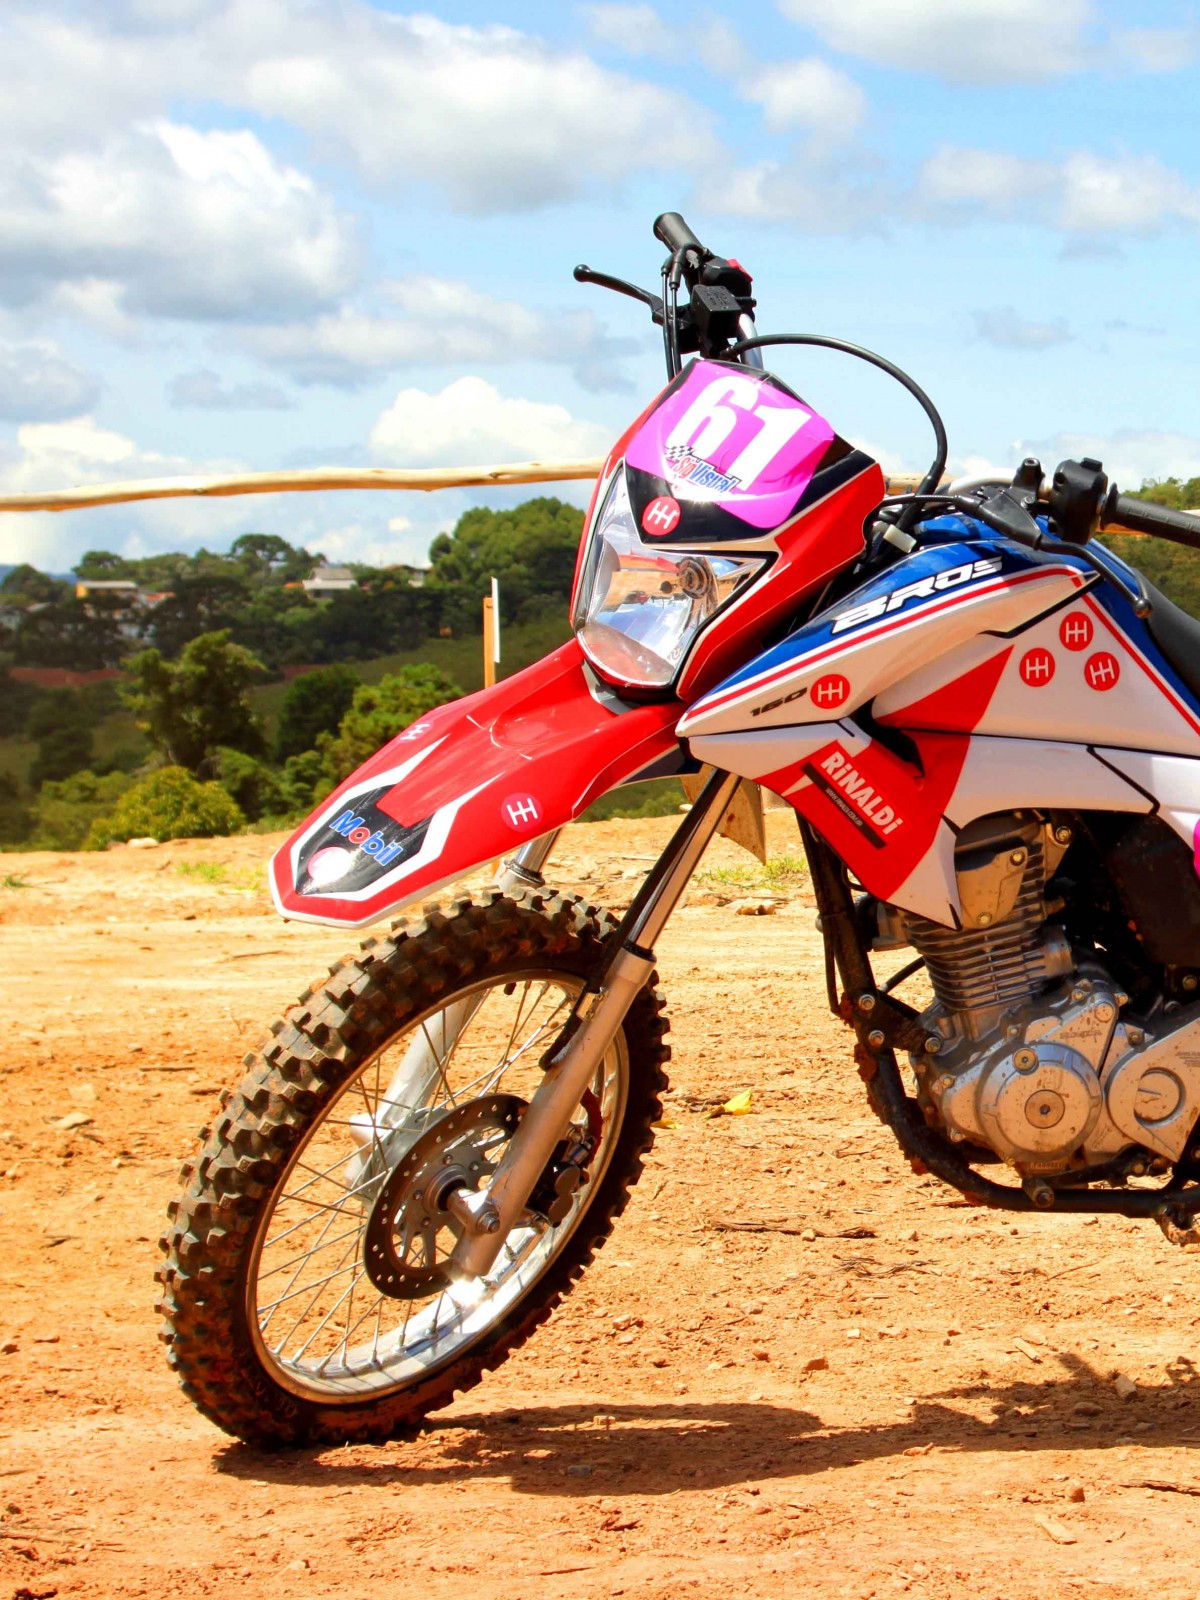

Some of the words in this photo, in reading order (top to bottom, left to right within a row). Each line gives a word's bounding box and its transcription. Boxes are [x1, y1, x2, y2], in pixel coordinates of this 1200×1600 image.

[665, 376, 811, 491] 61
[832, 556, 1003, 634] BROS
[750, 687, 808, 716] 160
[329, 810, 403, 867] Mobil
